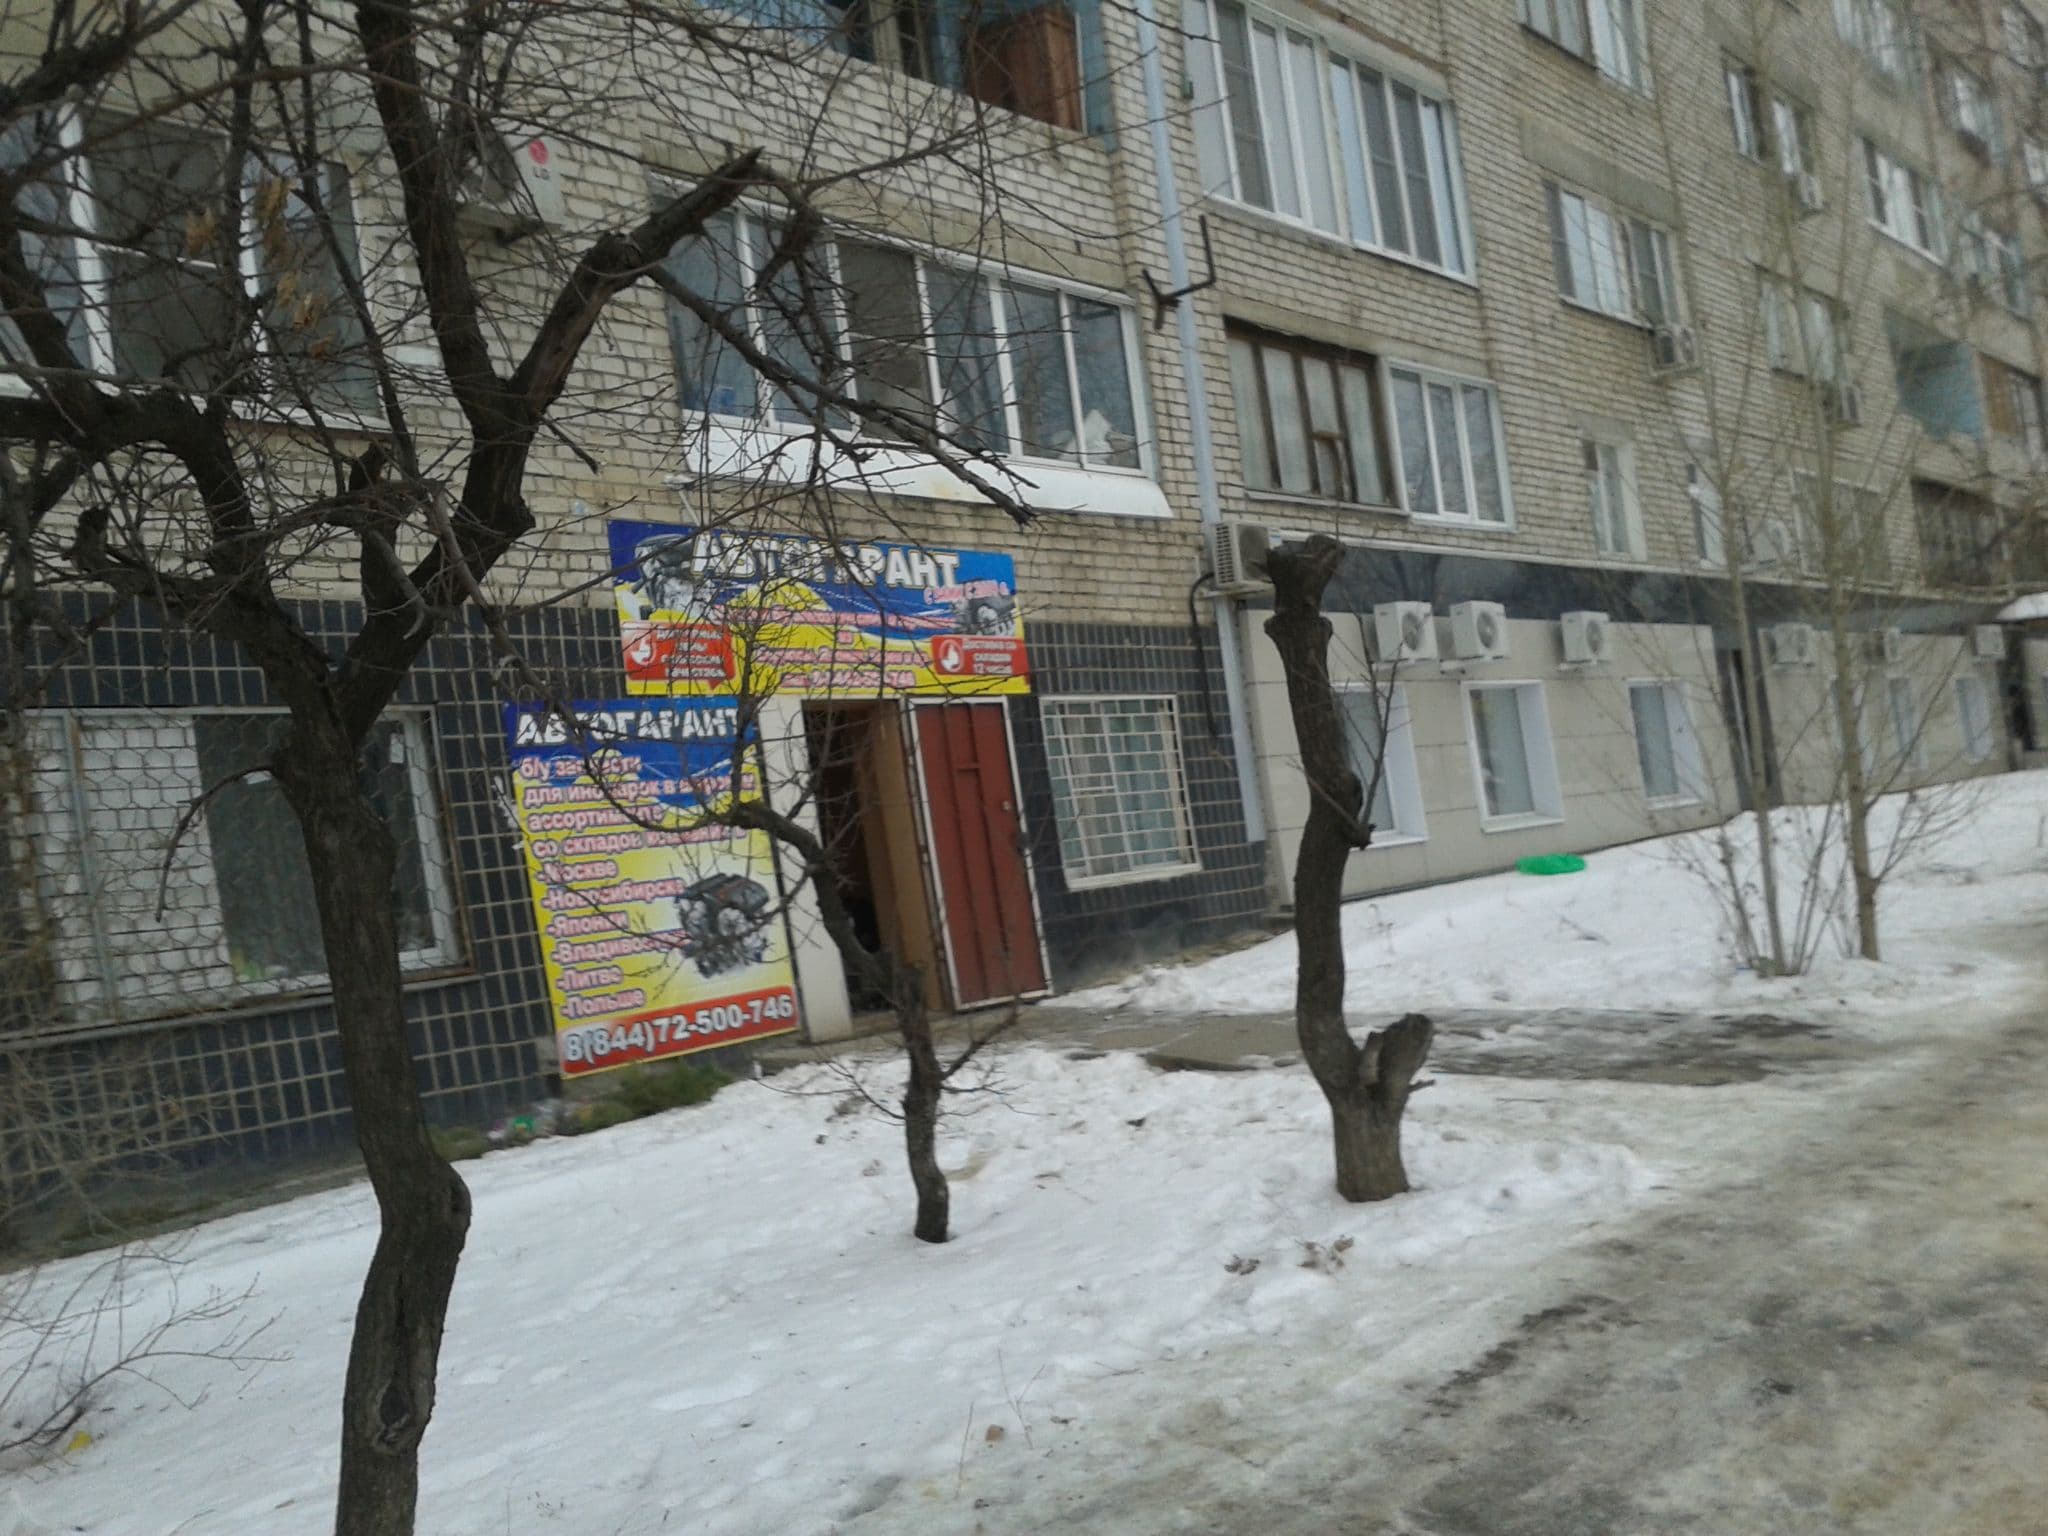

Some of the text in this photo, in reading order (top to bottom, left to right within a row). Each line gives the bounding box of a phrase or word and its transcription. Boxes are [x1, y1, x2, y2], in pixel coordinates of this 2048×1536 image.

[520, 756, 551, 781] б/у
[524, 786, 563, 808] для
[532, 841, 559, 858] со
[565, 994, 794, 1064] 8(844)72-500-746
